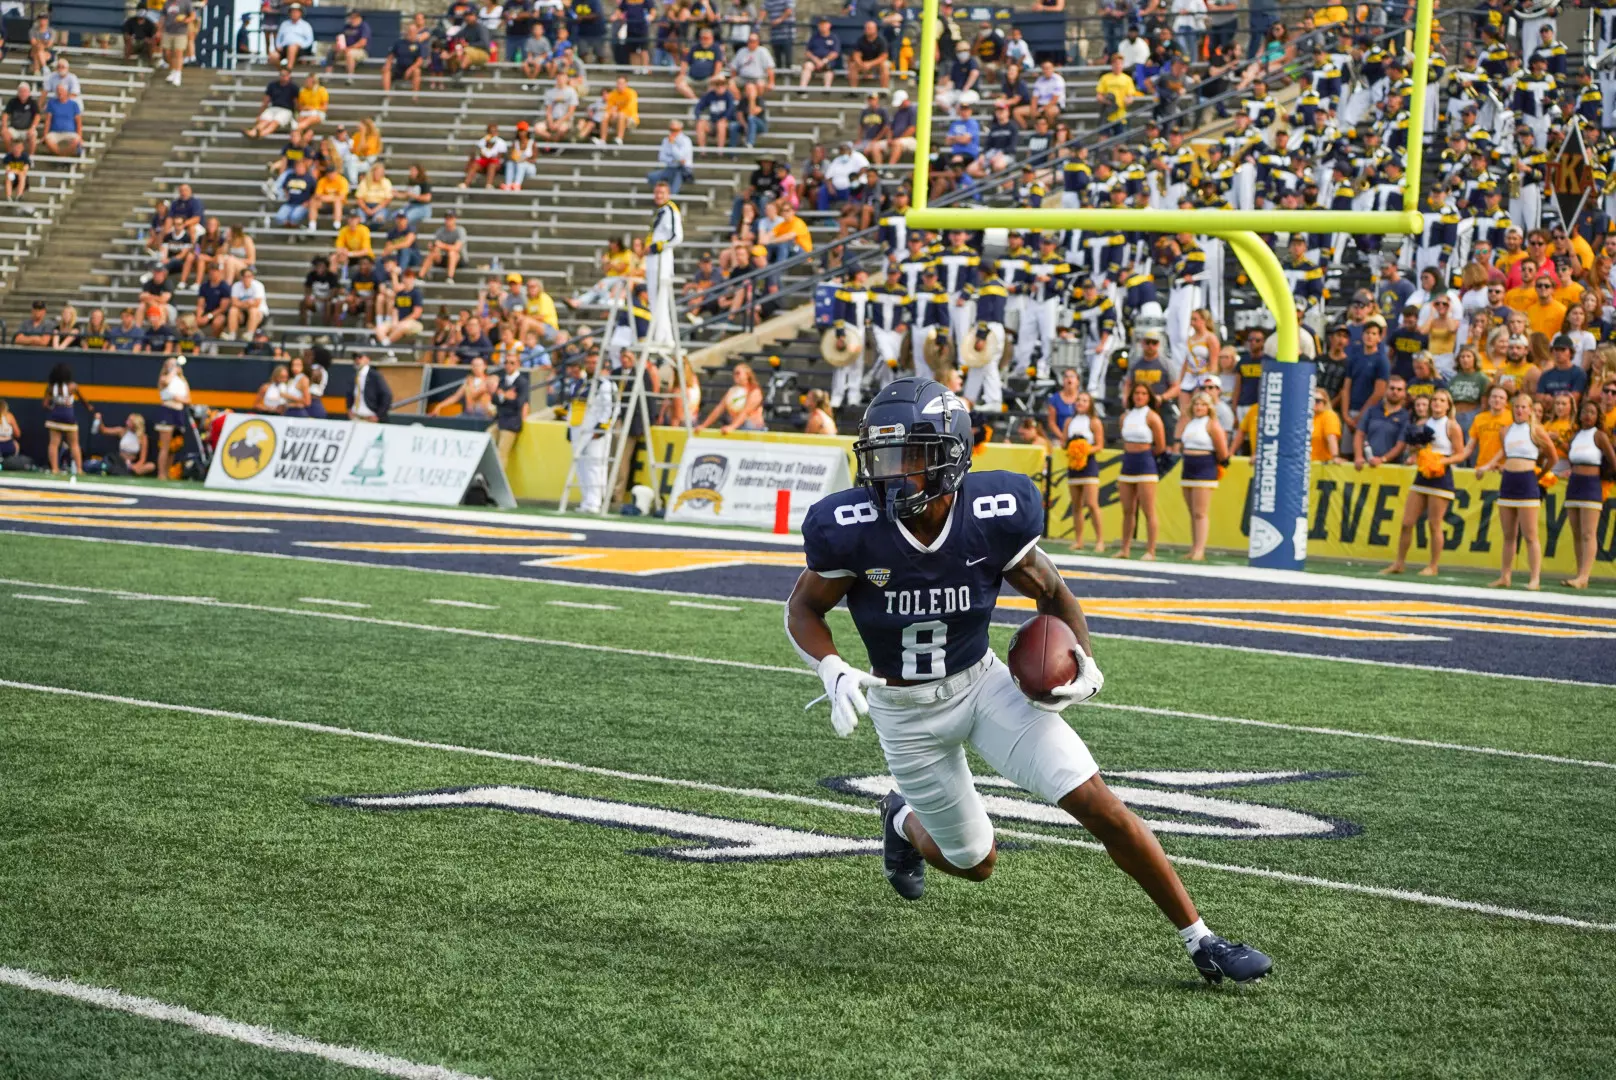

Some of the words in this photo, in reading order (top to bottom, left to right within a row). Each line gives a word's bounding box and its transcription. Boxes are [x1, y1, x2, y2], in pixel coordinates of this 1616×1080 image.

[1263, 371, 1284, 436] CENTER
[285, 426, 346, 441] BUFFALO
[280, 439, 339, 464] WILD
[411, 435, 480, 458] WAYNE
[274, 463, 331, 482] WINGS
[392, 466, 468, 488] LUMBER
[1260, 440, 1279, 513] MEDICAL
[834, 502, 878, 526] 8
[973, 493, 1017, 519] 8
[884, 585, 971, 615] TOLEDO
[902, 620, 948, 680] 8
